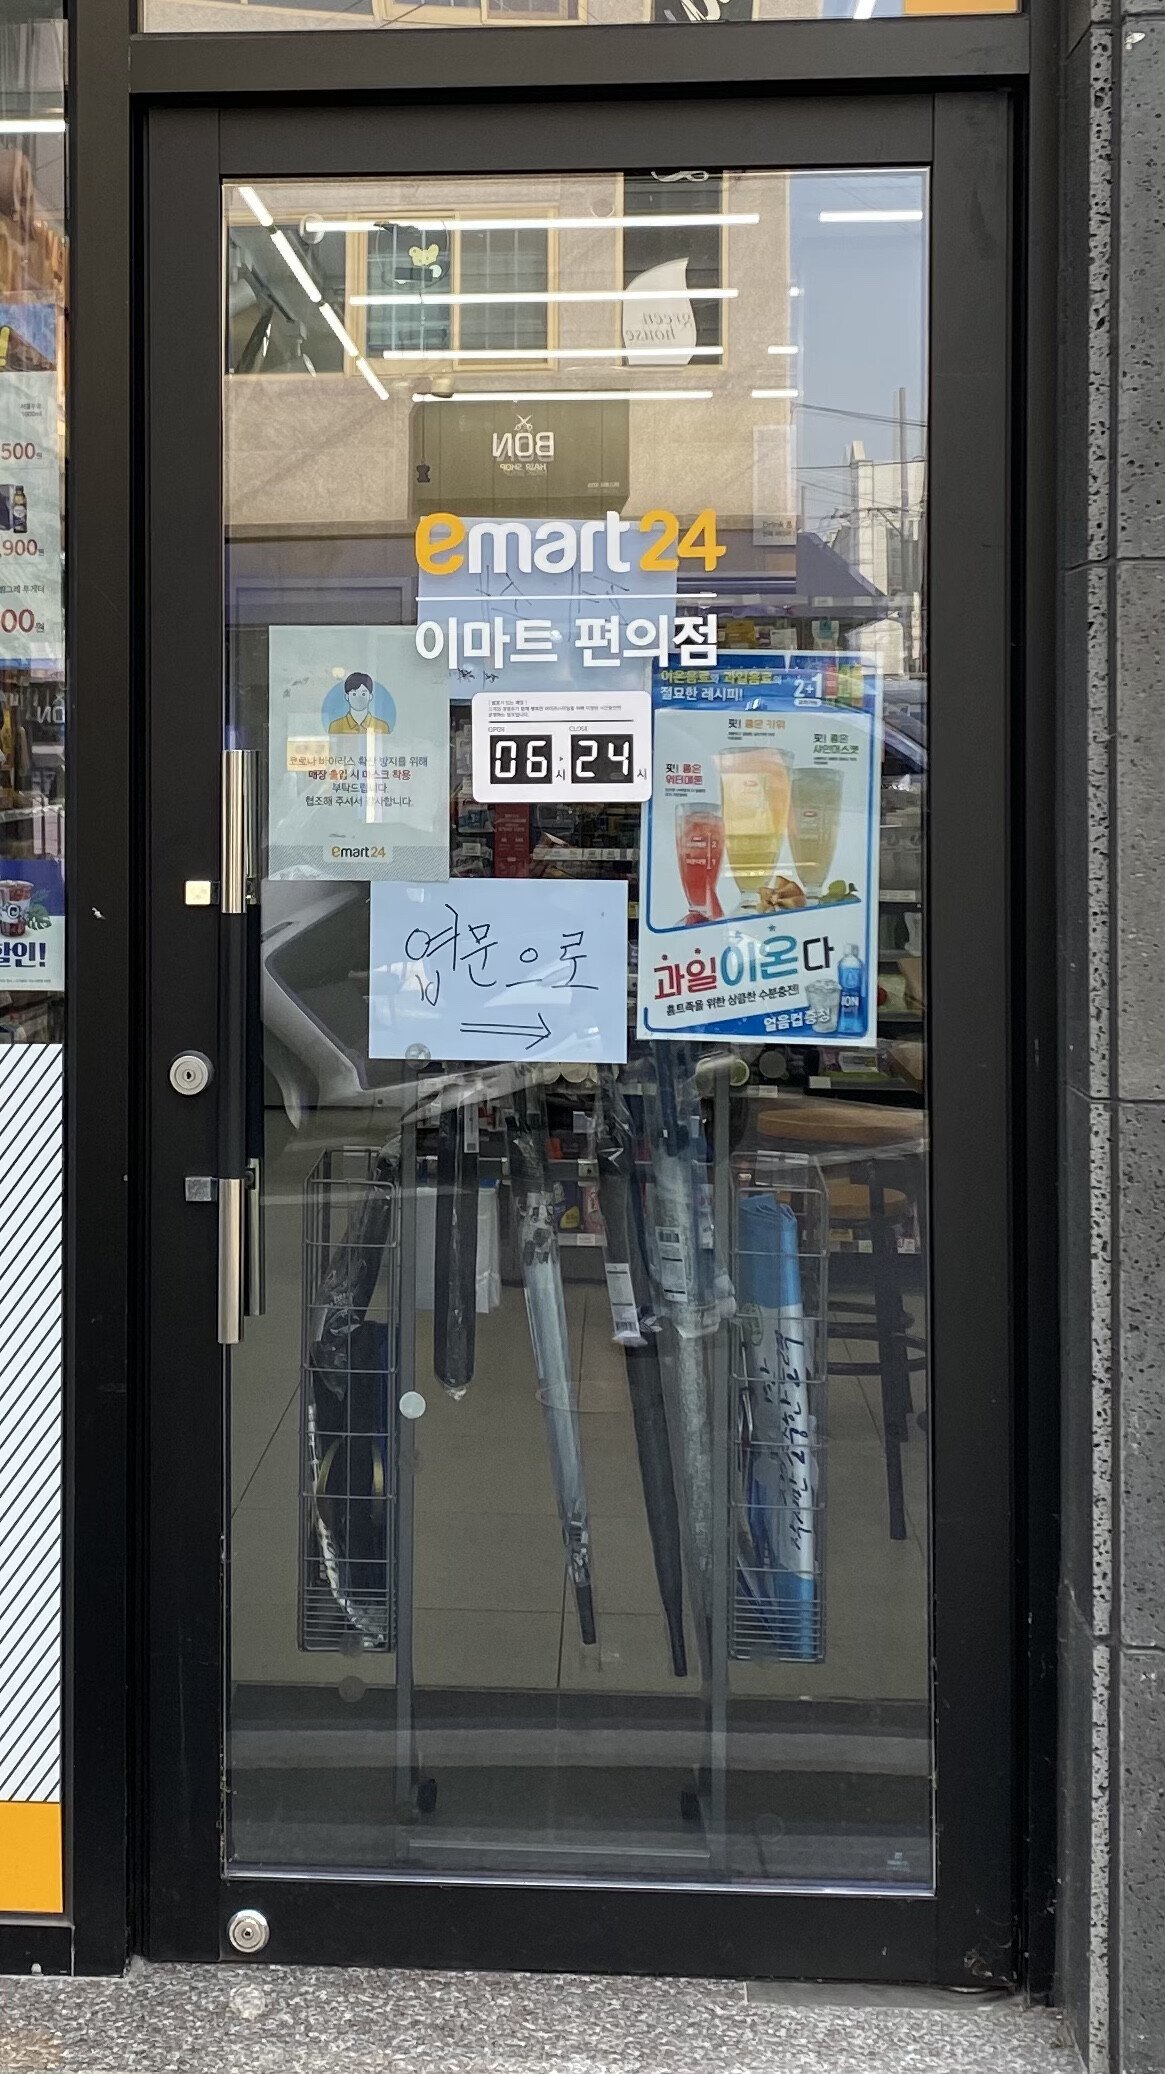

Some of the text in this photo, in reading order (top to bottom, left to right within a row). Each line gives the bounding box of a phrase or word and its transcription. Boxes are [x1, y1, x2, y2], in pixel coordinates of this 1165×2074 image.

[415, 614, 718, 669] 이마트 편의점
[702, 687, 743, 702] 레시피!
[793, 673, 823, 699] 2+1
[379, 756, 406, 767] 방지를
[409, 756, 428, 768] 위해
[494, 739, 647, 781] 06 시 24 시
[308, 769, 327, 781] 매장
[350, 770, 360, 780] 시
[392, 769, 411, 781] 착용
[305, 796, 333, 807] 협조해
[335, 796, 363, 807] 주셔서
[666, 983, 800, 1016] 홈트족을 위한 상큼한 수분충전!
